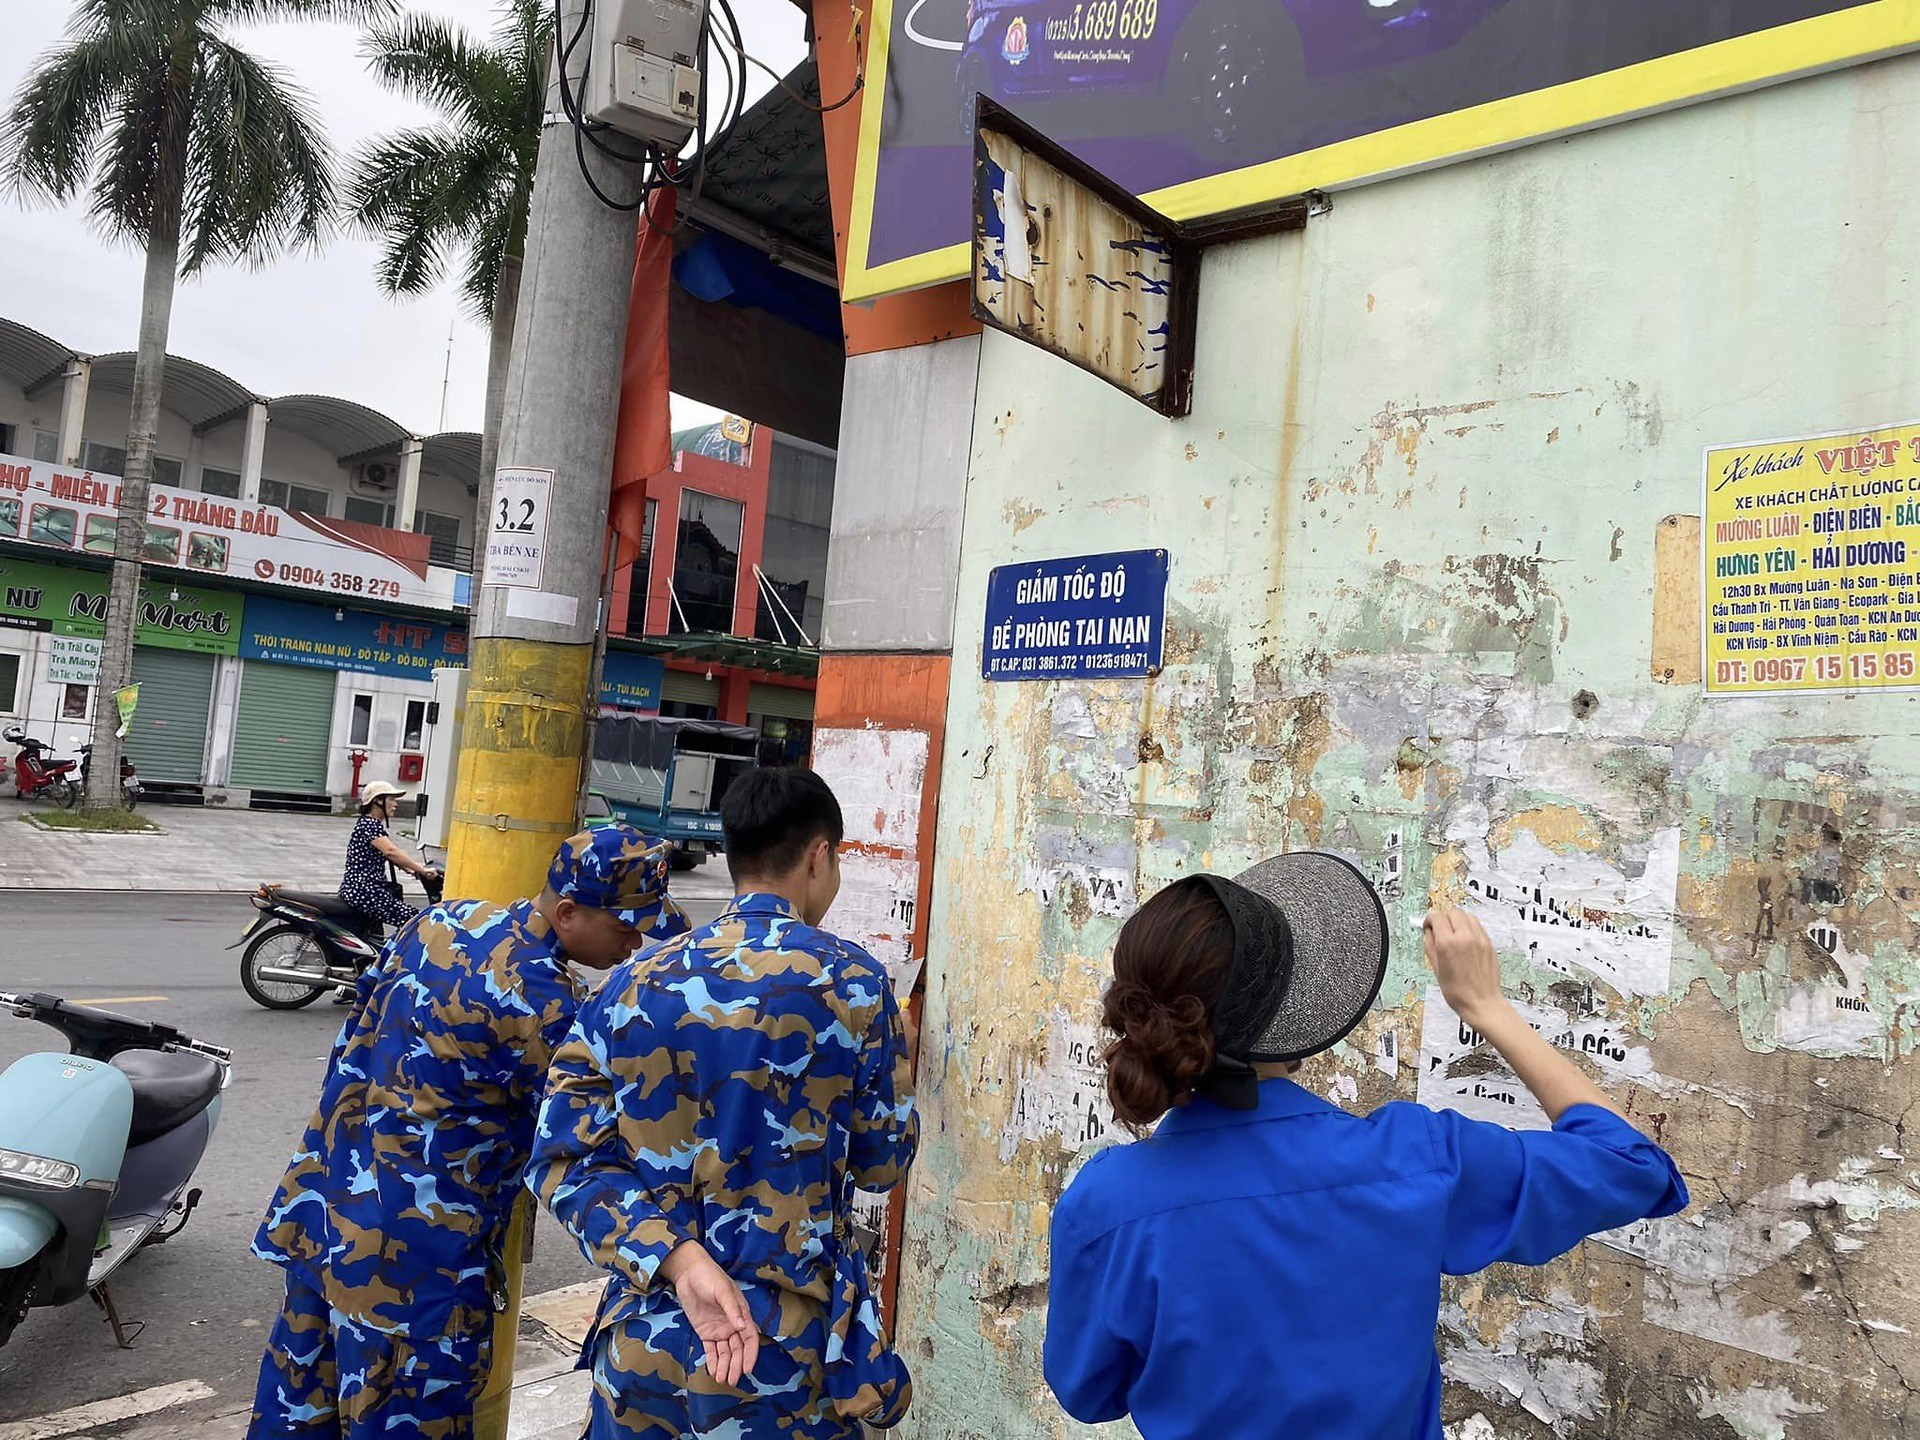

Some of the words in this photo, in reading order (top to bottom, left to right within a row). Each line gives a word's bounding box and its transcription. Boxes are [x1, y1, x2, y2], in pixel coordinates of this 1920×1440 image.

[1120, 0, 1158, 39] 689
[1713, 454, 1750, 492] Xe
[1751, 446, 1804, 477] khách
[1815, 436, 1901, 477] VIỆT
[1735, 497, 1752, 510] XE
[1757, 490, 1805, 507] KHÁCH
[1810, 481, 1848, 503] CHẤT
[1853, 478, 1903, 501] LƯỢNG
[153, 494, 167, 518] 2
[173, 497, 236, 531] THÁNG
[496, 497, 535, 531] 3.2
[1716, 514, 1762, 543] MƯỜNG
[1766, 511, 1800, 538] LUÂN
[1813, 508, 1844, 537] ĐIỆN
[1849, 503, 1881, 531] BIÊN
[524, 547, 540, 558] XE
[1716, 552, 1759, 577] HƯNG
[1765, 547, 1795, 573] YÊN
[1812, 538, 1840, 569] HẢI
[1846, 541, 1905, 567] DƯƠNG
[279, 563, 325, 586] 0904
[330, 572, 363, 592] 358
[368, 578, 400, 598] 279
[1016, 568, 1058, 604] GIẢM
[1063, 564, 1095, 600] TỐC
[1100, 564, 1126, 603] ĐỘ
[1722, 584, 1750, 599] 12h30
[1754, 584, 1766, 597] Bx
[1840, 577, 1854, 590] Na
[1889, 572, 1913, 589] Điện
[5, 585, 43, 610] NỮ
[1731, 602, 1757, 615] Thanh
[1813, 596, 1839, 610] Giang
[1848, 593, 1888, 608] Ecopark
[1898, 591, 1913, 604] Gia
[137, 602, 230, 635] Mart
[992, 615, 1013, 650] ĐỀ
[1015, 616, 1070, 649] PHÒNG
[1076, 618, 1103, 645] TAI
[1109, 615, 1150, 649] NẠN
[1868, 611, 1886, 625] KCN
[1890, 611, 1902, 623] An
[280, 637, 312, 652] TRANG
[314, 642, 335, 656] NAM
[1726, 637, 1744, 650] KCN
[1746, 636, 1768, 651] Visip
[1776, 634, 1789, 648] BX
[1897, 628, 1917, 641] KCN
[1022, 656, 1036, 670] 031
[1038, 654, 1077, 669] 3861.372
[1717, 660, 1747, 684] ĐT:
[1753, 658, 1806, 683] 0967
[1815, 656, 1842, 680] 15
[1850, 654, 1877, 679] 15
[1885, 652, 1914, 677] 85
